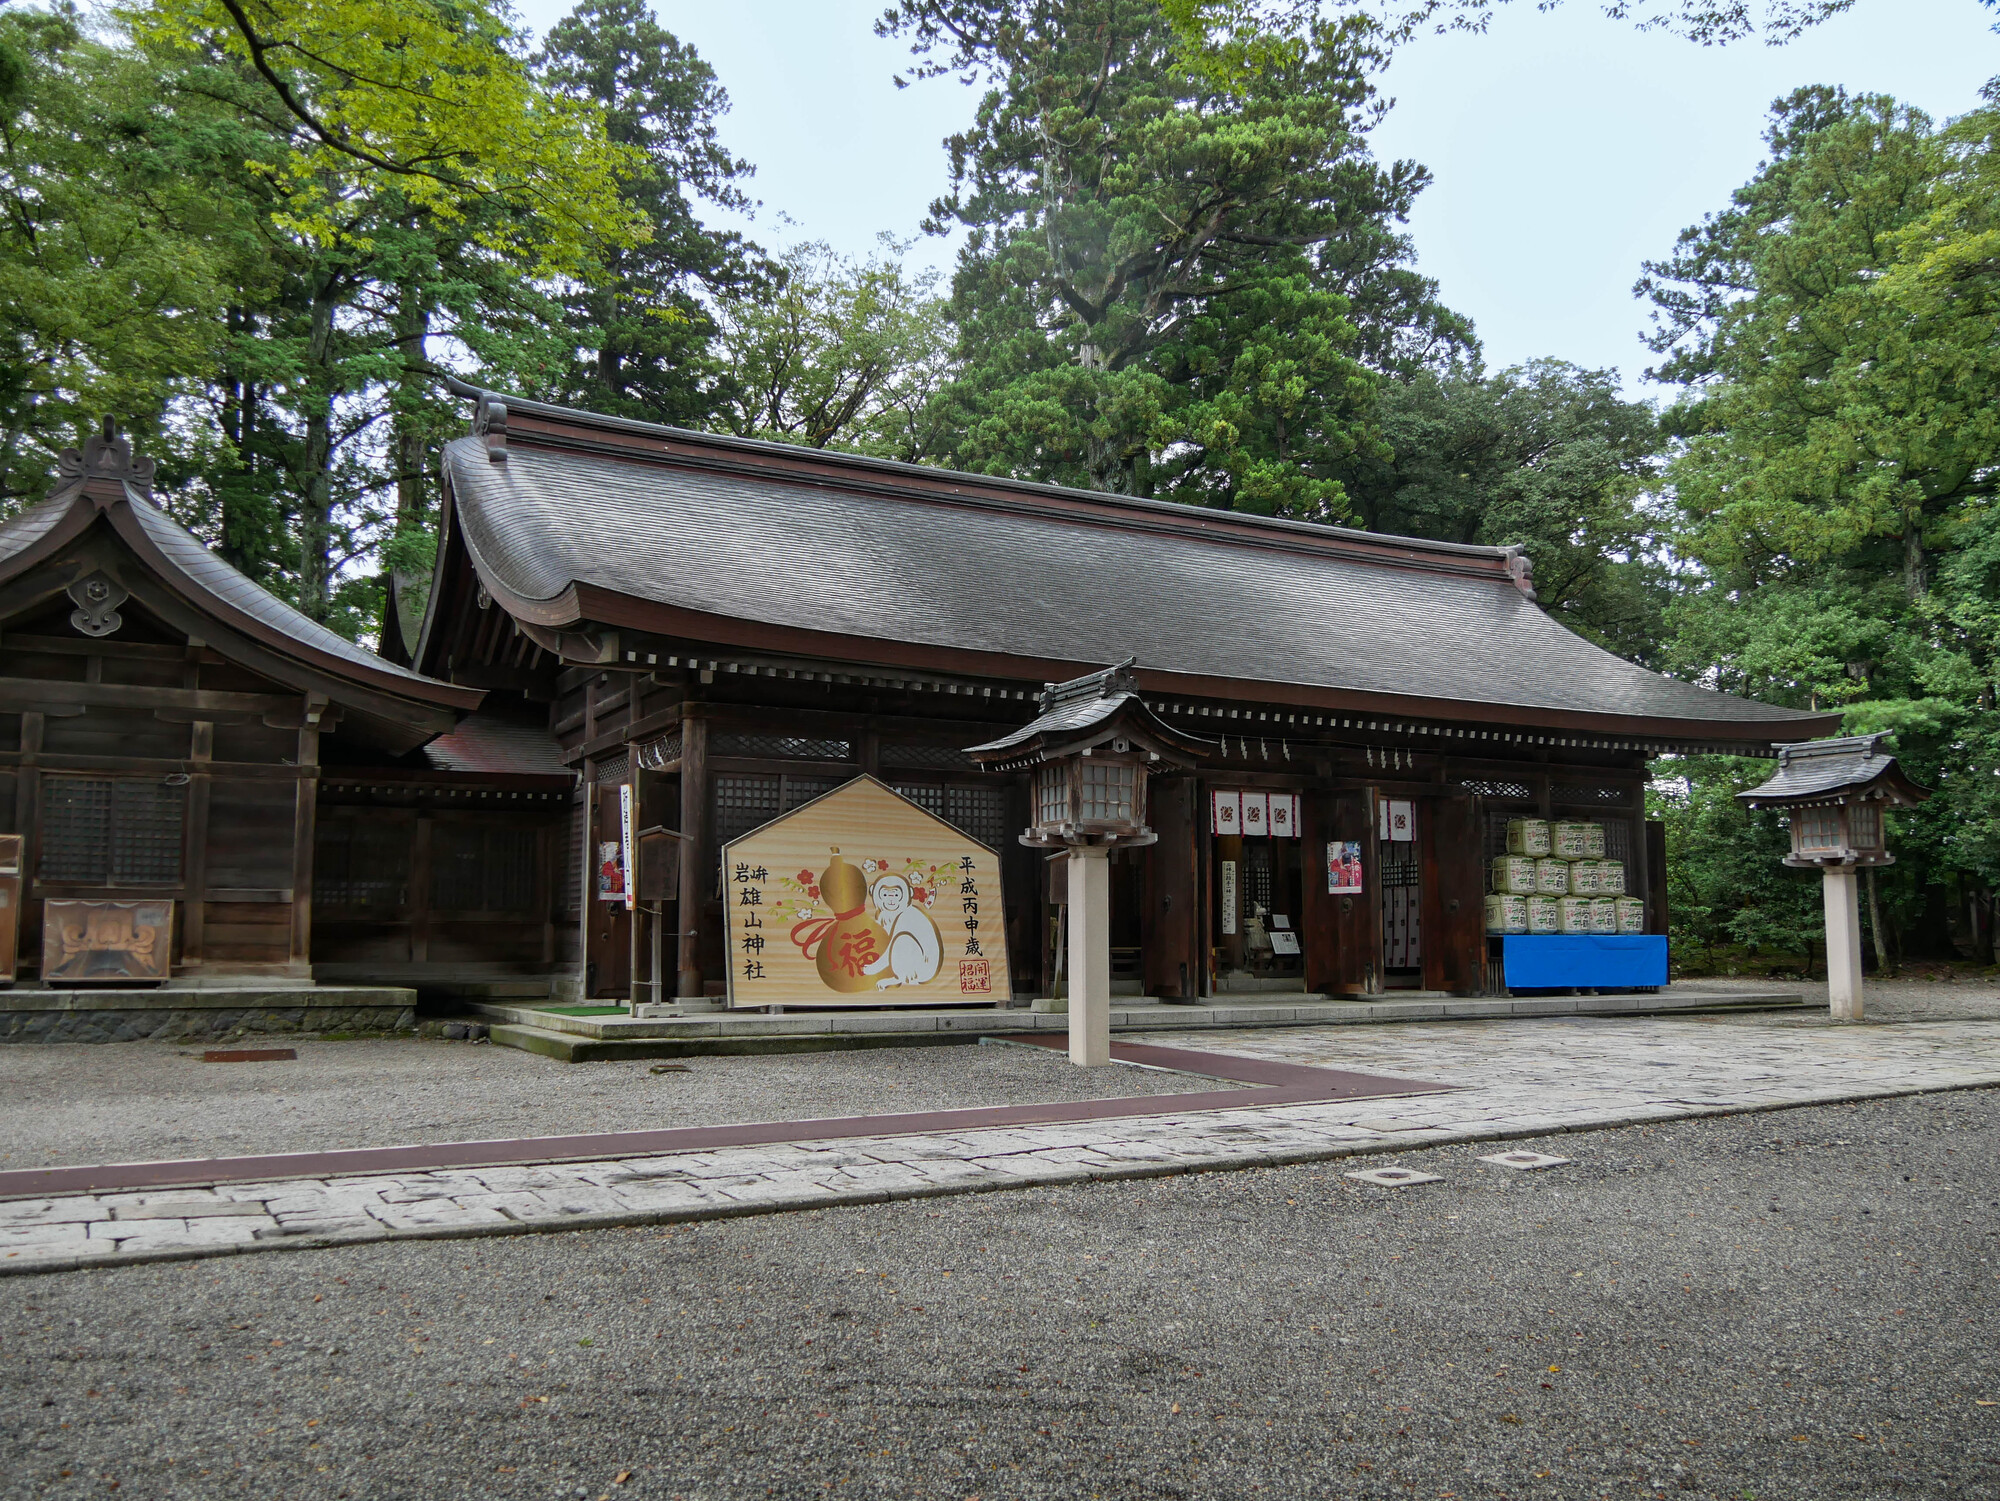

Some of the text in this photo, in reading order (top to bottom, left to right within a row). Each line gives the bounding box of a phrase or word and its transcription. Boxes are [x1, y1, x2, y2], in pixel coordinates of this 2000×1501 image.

[959, 856, 983, 957] 平成丙申歳
[839, 928, 880, 978] 福
